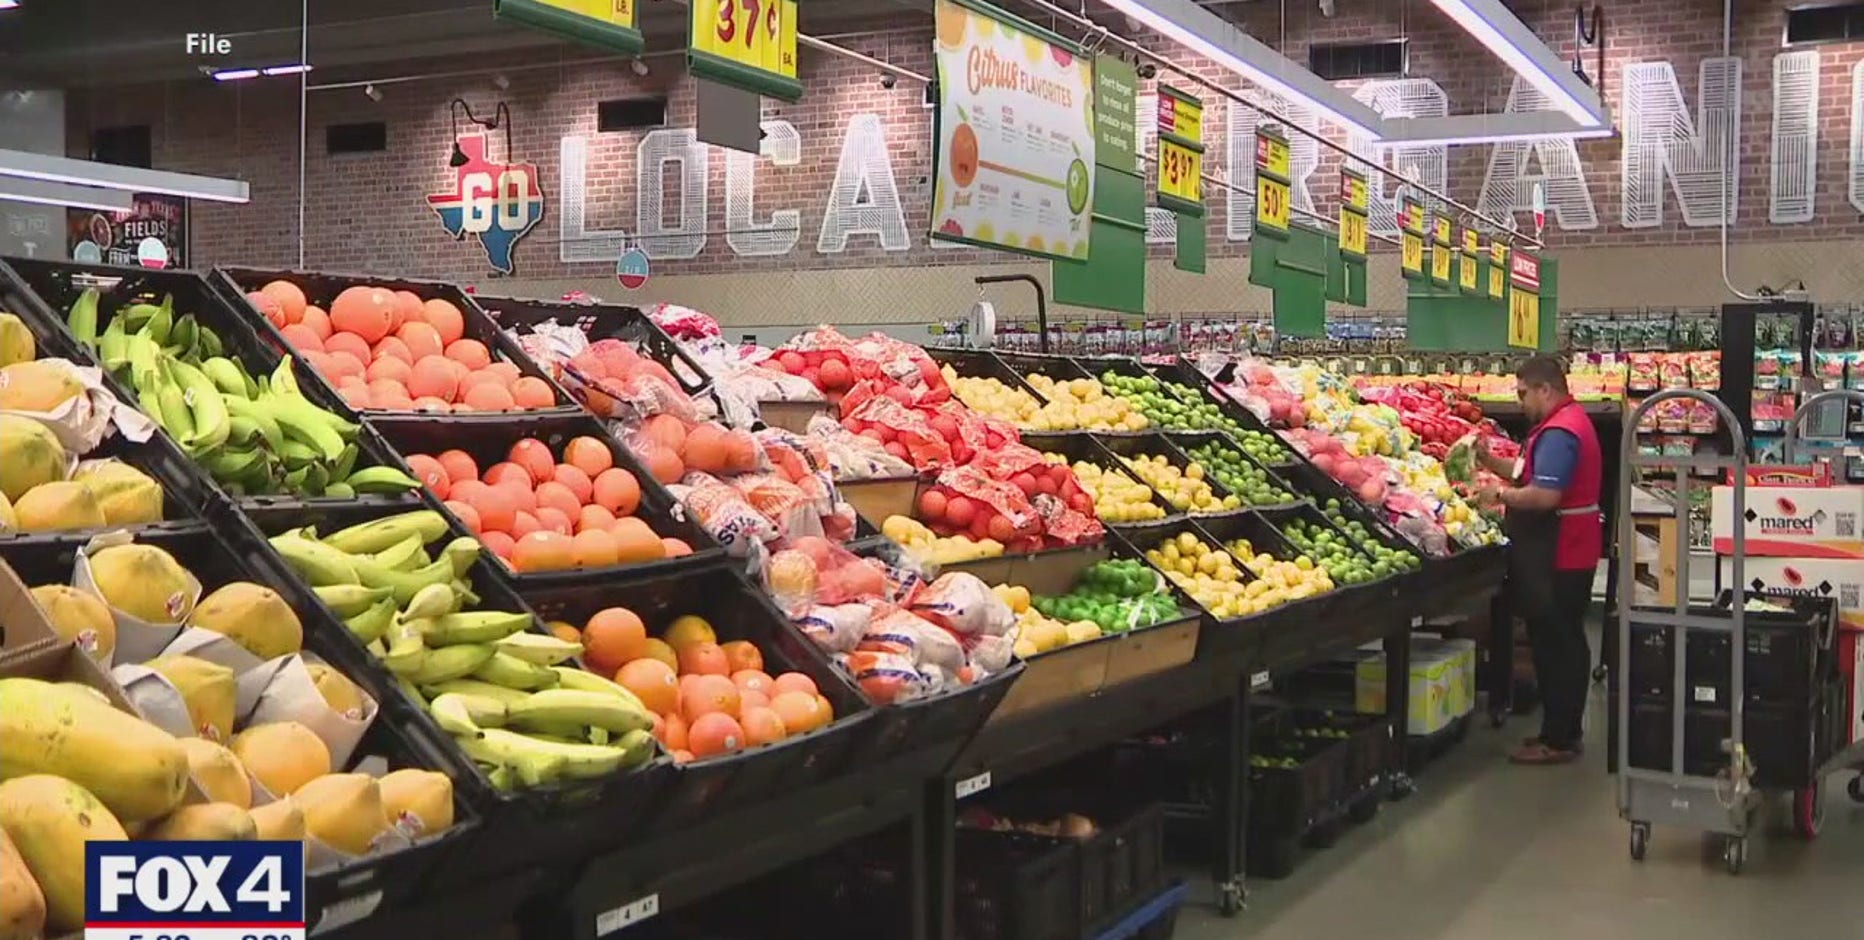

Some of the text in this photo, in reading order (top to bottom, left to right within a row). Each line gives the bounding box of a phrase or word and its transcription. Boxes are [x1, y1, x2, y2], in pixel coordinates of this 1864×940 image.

[967, 45, 1020, 95] Citrus
[462, 168, 529, 232] GO
[125, 221, 166, 237] FIELDS
[1761, 515, 1814, 529] mared
